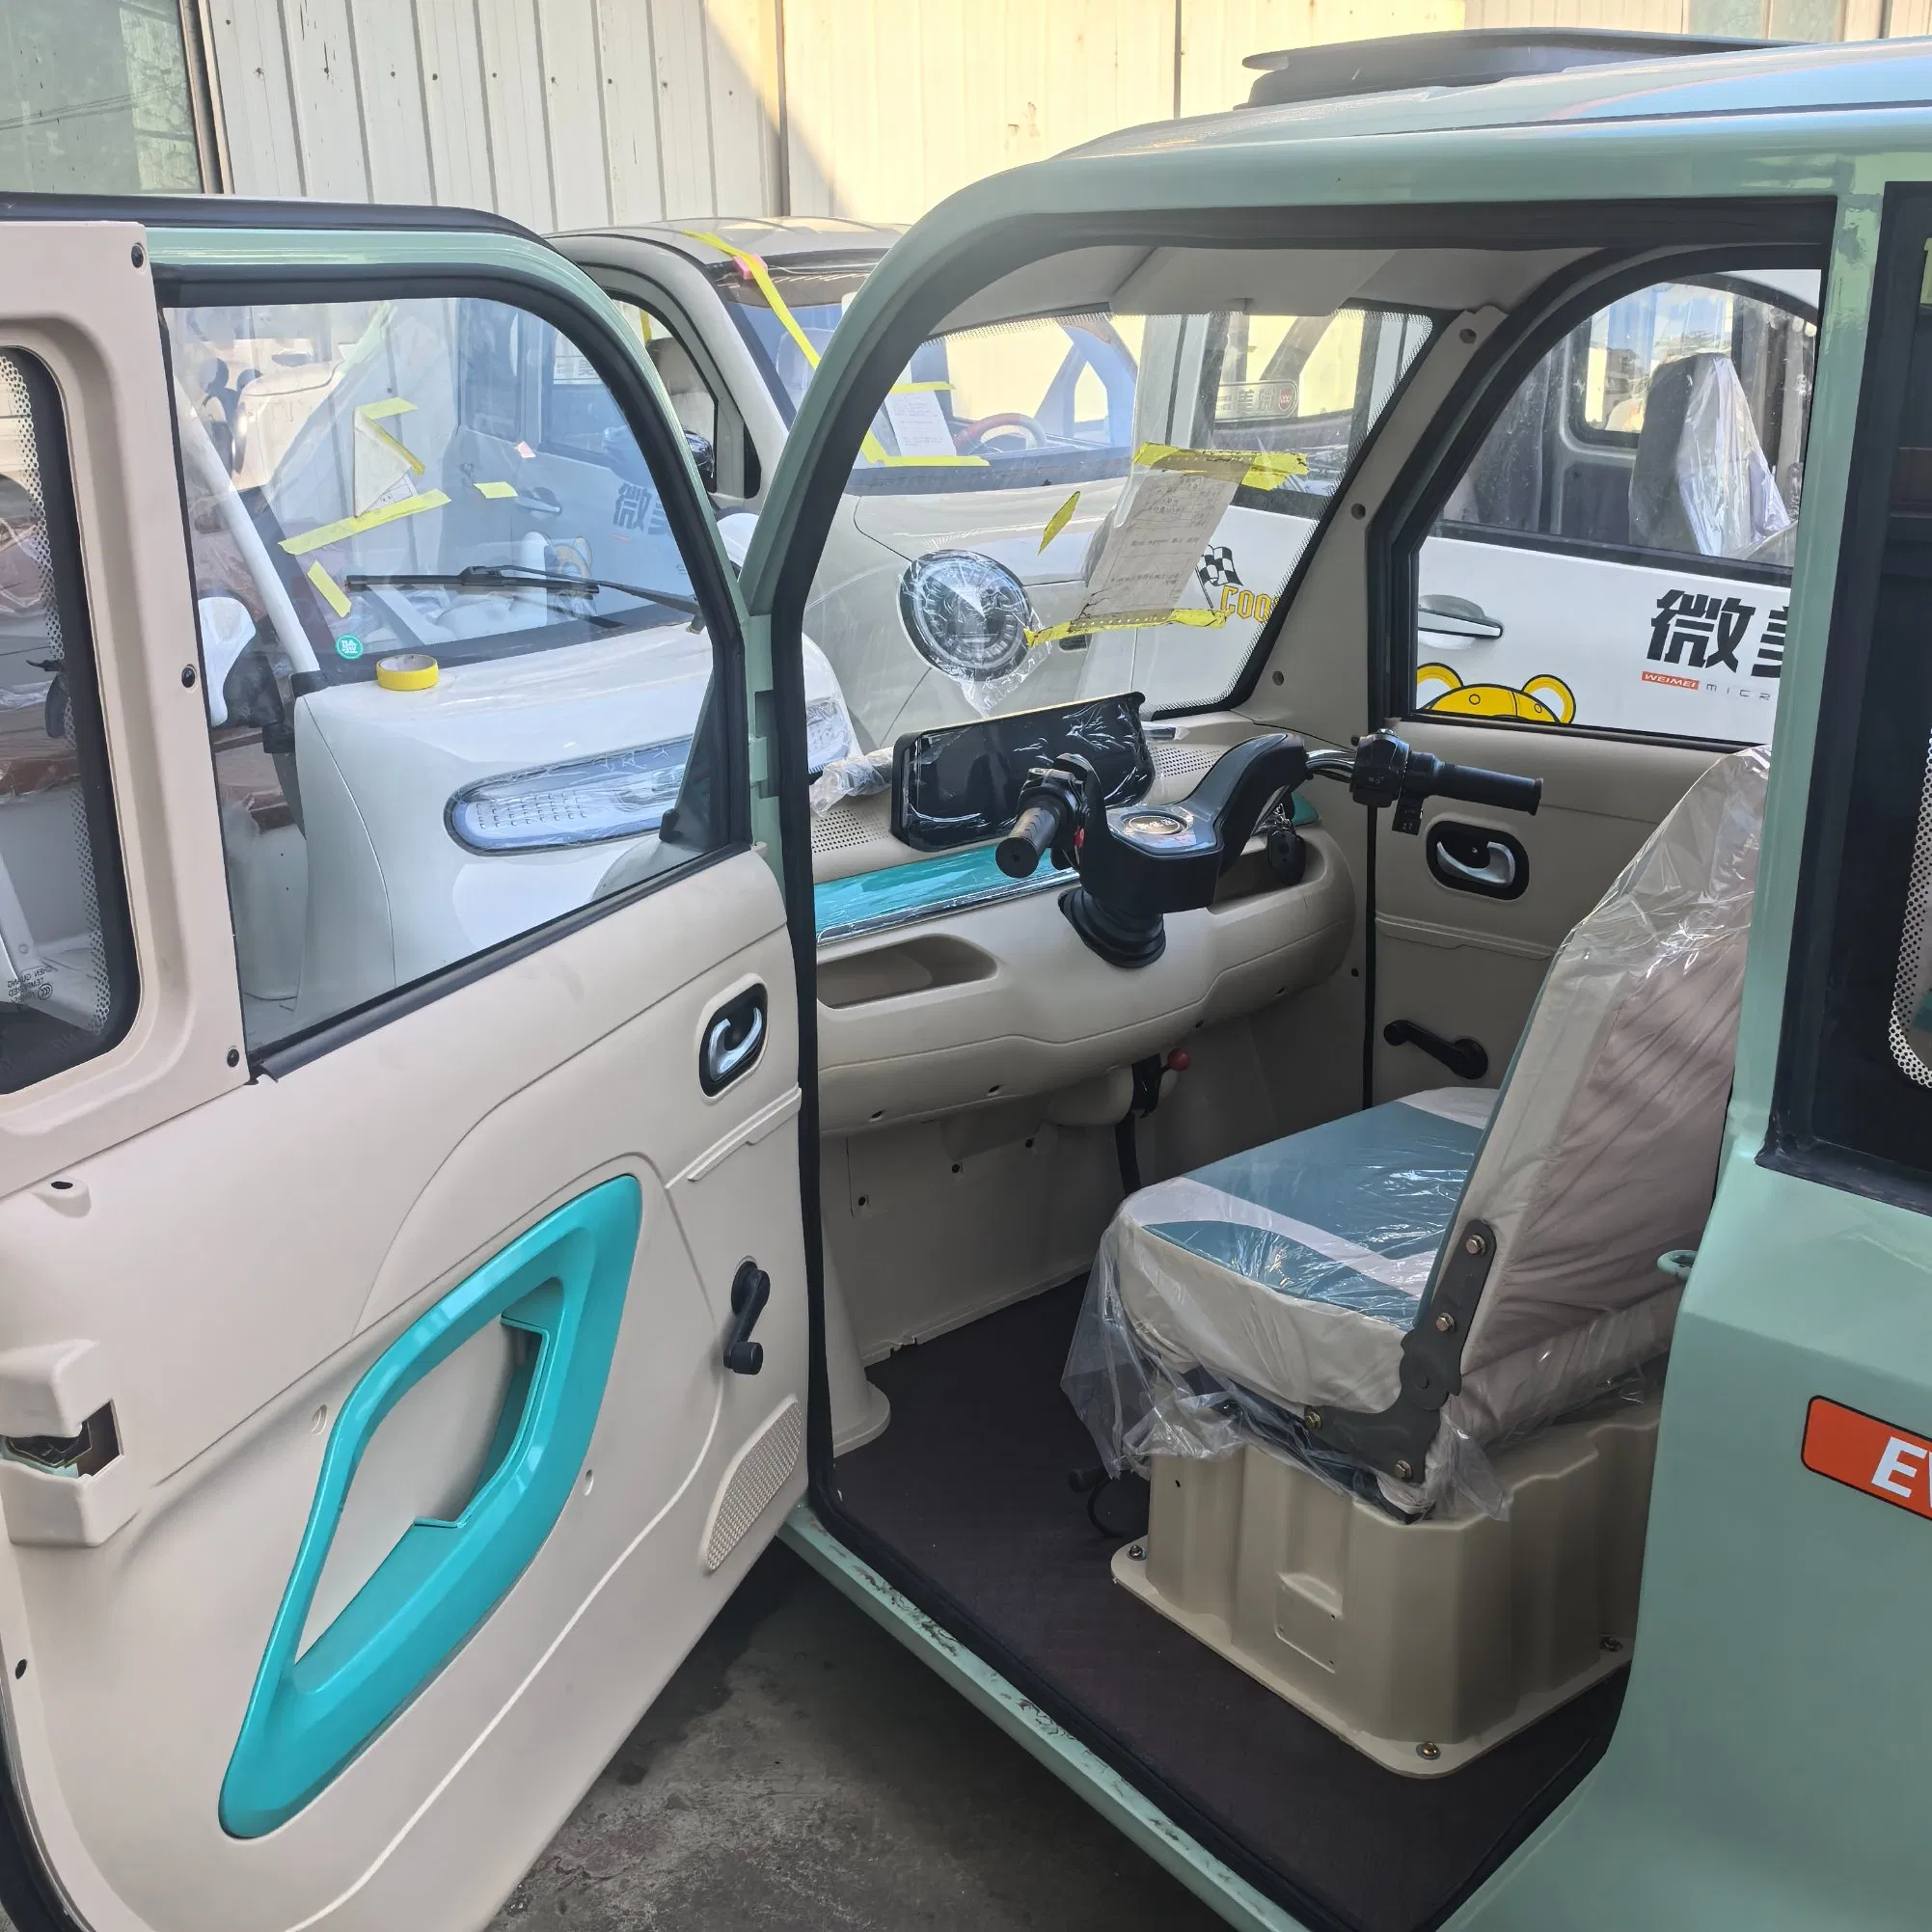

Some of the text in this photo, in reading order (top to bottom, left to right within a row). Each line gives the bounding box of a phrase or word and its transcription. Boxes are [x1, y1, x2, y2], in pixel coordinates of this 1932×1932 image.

[1220, 585, 1279, 623] COO
[1644, 673, 1698, 689] WEIMEI
[1871, 1436, 1932, 1508] E
